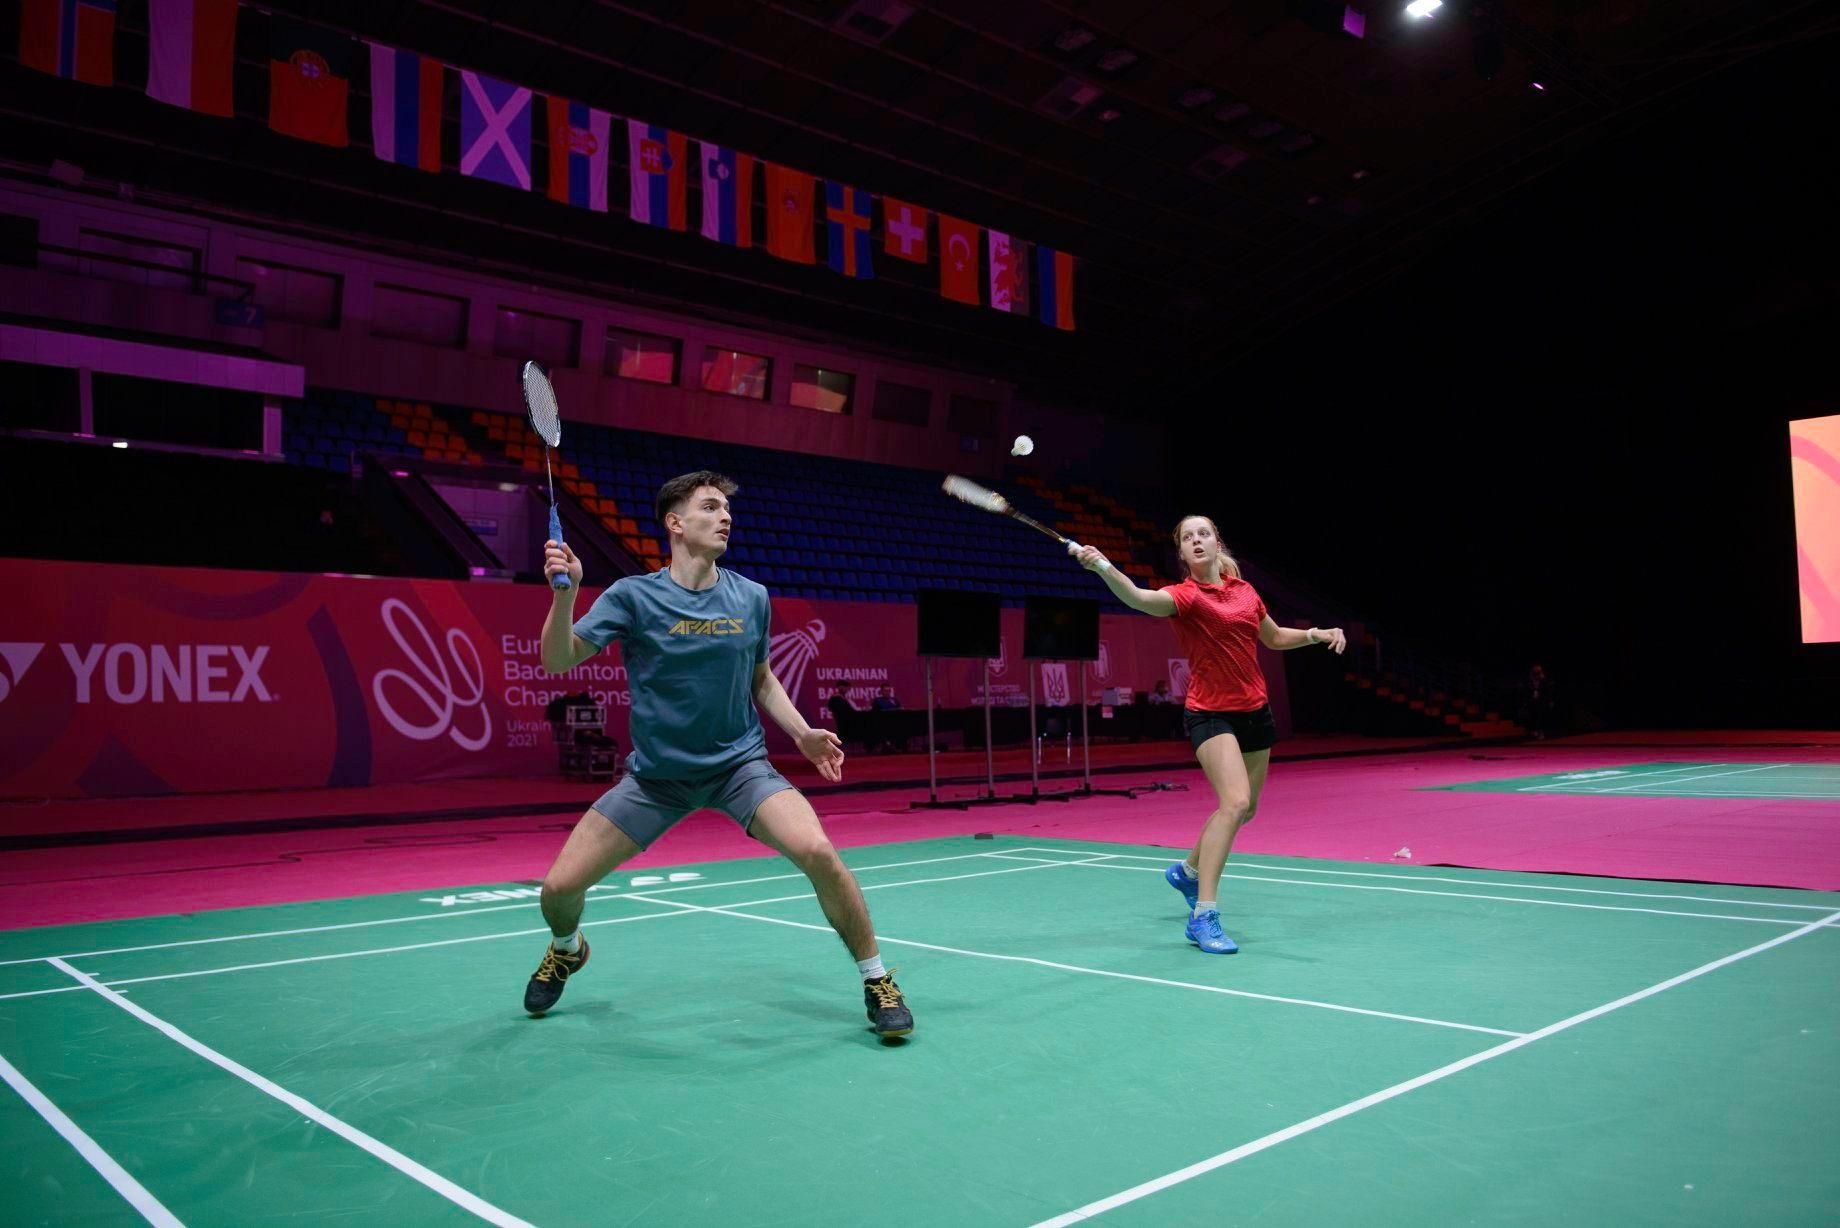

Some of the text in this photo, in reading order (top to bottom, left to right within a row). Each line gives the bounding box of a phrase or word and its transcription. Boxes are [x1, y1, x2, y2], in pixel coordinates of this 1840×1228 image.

[668, 618, 744, 635] APACS
[58, 642, 271, 704] YONEX
[816, 667, 888, 680] UKRAINIAN
[504, 685, 632, 706] Chamions
[817, 687, 895, 700] BAMINTO
[506, 719, 552, 732] Ukrain
[506, 733, 537, 748] 2021
[419, 885, 620, 906] YNEX
